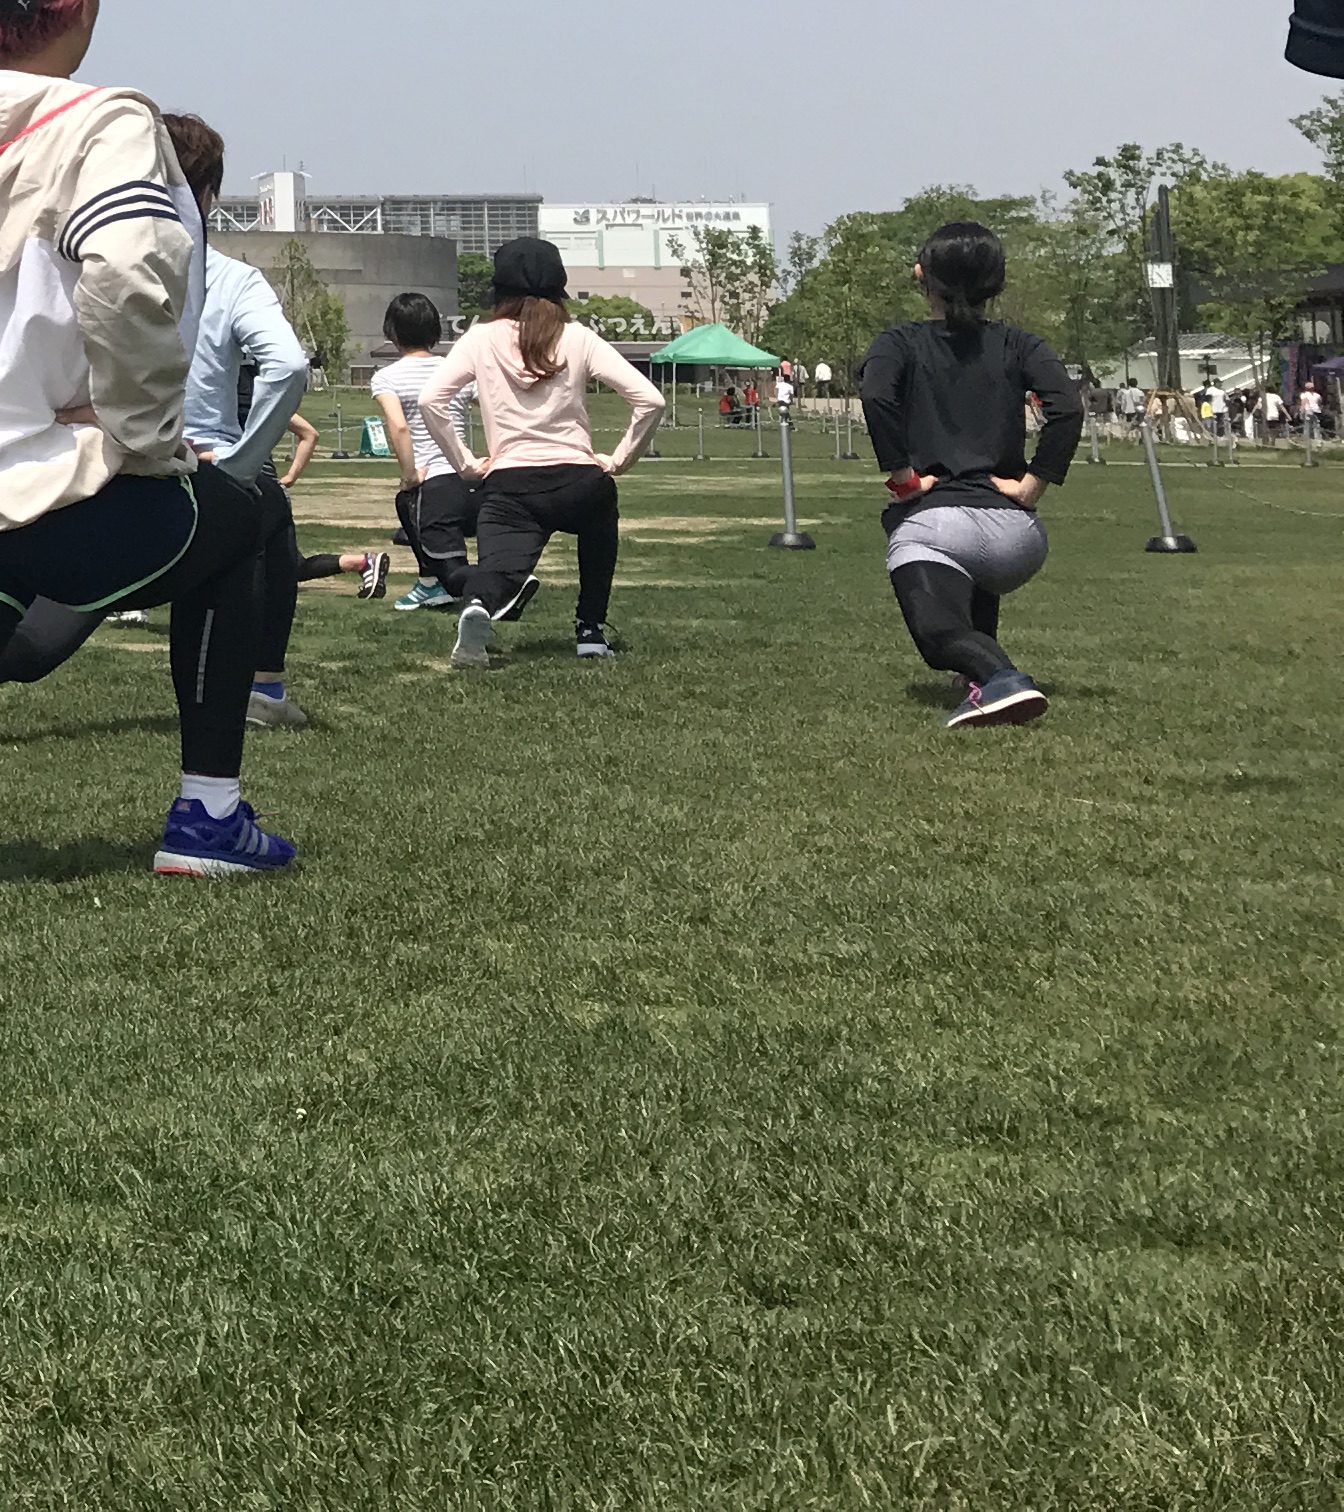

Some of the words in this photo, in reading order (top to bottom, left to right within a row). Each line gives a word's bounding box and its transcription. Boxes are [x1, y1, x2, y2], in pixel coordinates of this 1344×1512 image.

[596, 207, 683, 225] スパワールド
